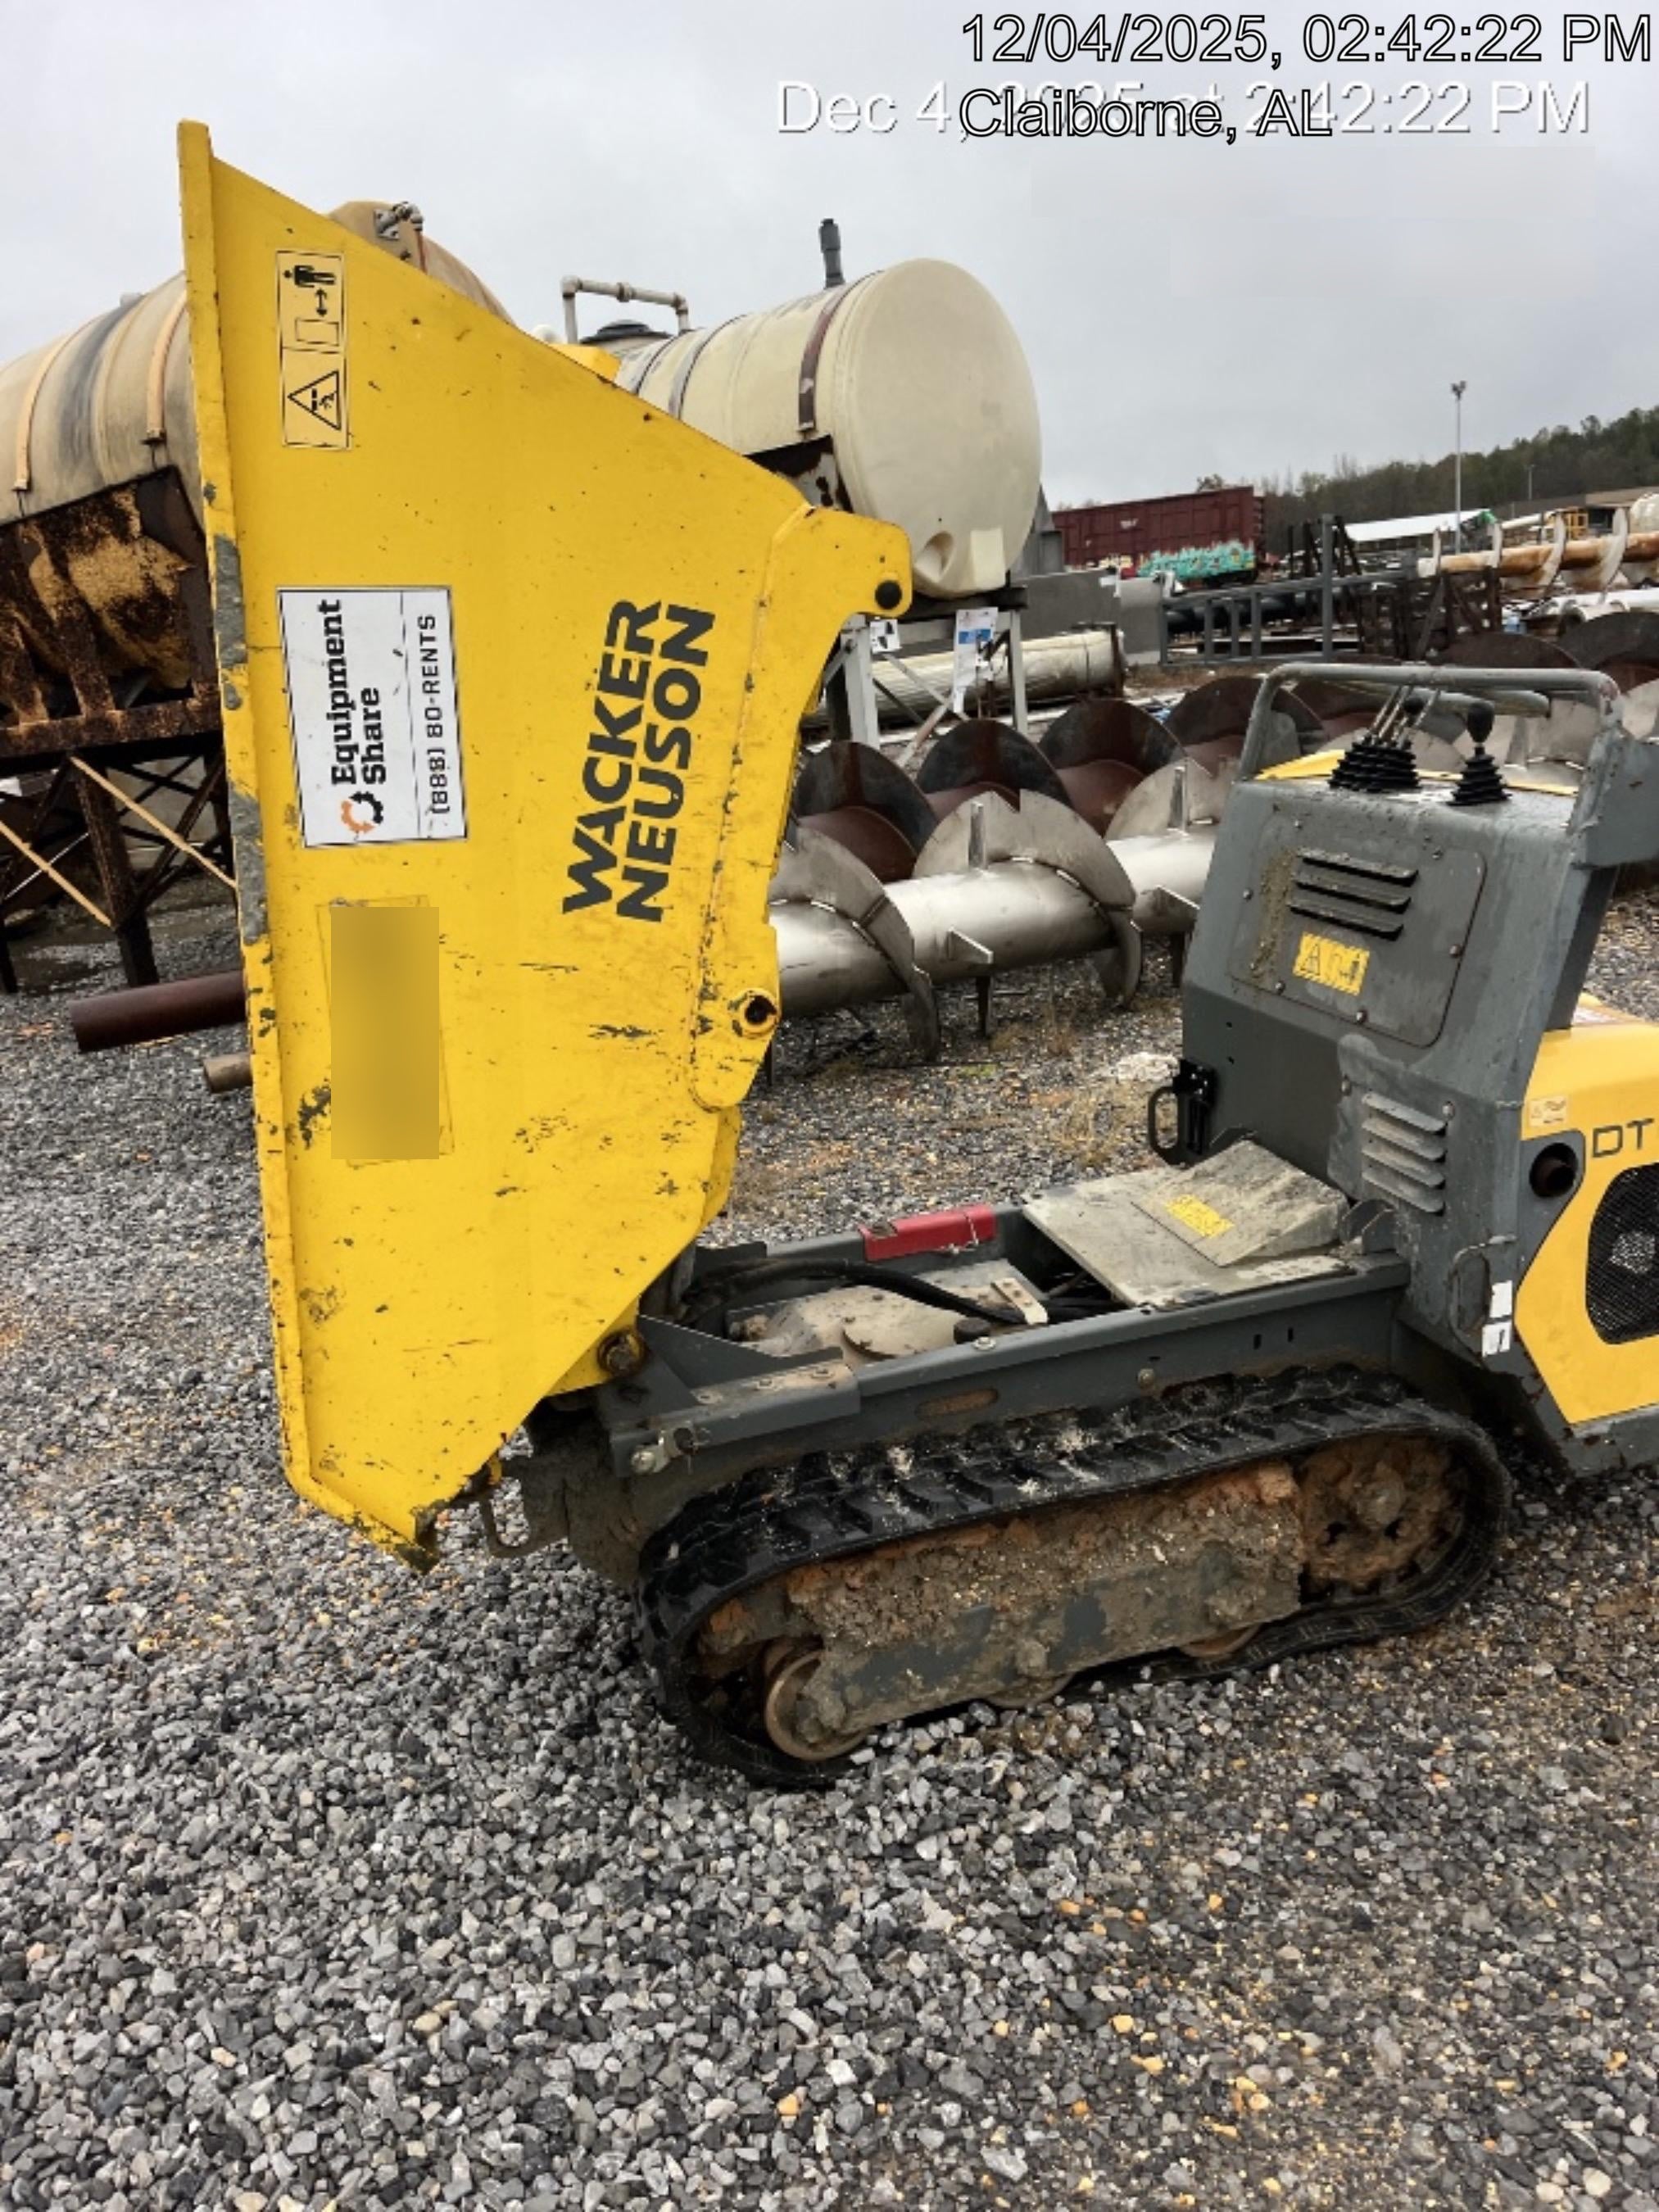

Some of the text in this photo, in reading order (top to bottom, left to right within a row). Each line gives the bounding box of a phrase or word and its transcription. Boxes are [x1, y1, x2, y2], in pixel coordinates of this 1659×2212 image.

[318, 599, 359, 785] Equipment
[360, 687, 388, 785] Share
[417, 614, 451, 814] (888) 80-RENTS
[562, 601, 662, 914] WACKER
[616, 604, 715, 922] NEUSON
[1592, 1117, 1655, 1158] DT
